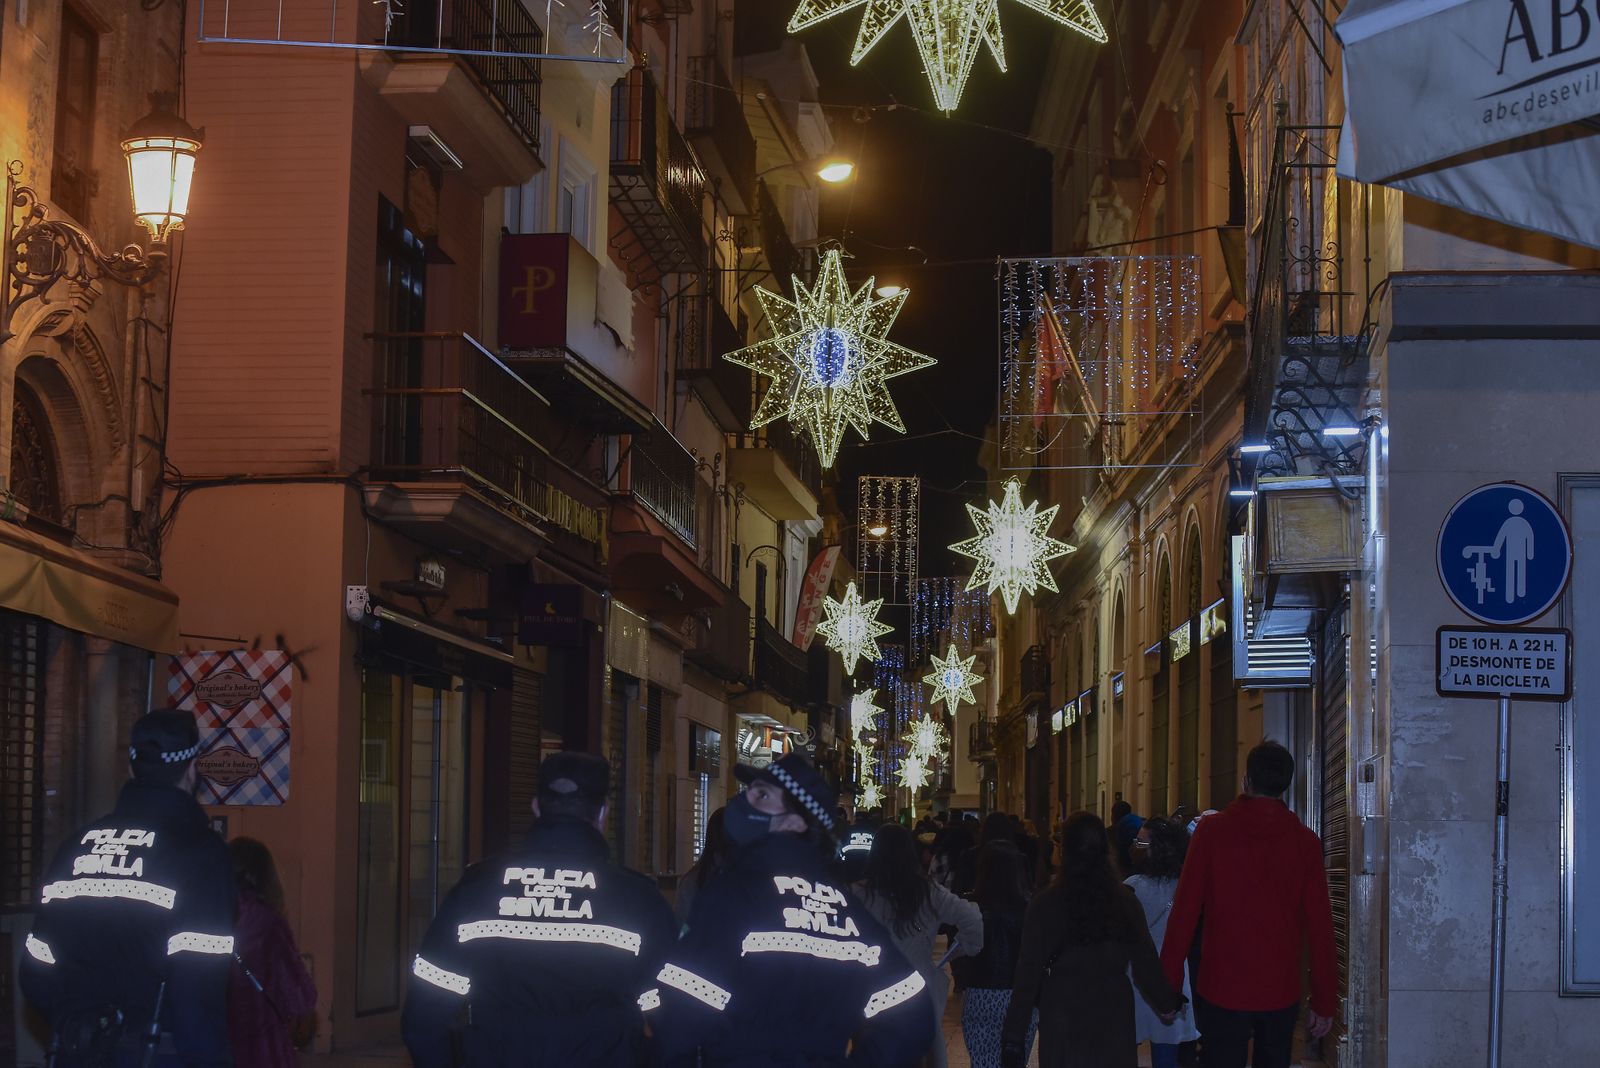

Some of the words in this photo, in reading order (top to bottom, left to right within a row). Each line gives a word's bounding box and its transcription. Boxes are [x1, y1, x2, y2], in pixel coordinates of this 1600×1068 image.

[1496, 0, 1600, 75] AB
[1449, 637, 1467, 649] DE
[1472, 638, 1487, 649] 10
[1490, 639, 1503, 650] H.
[1508, 639, 1518, 651] A
[1523, 639, 1541, 651] 22
[1544, 640, 1557, 652] H.
[1450, 655, 1532, 670] DESMONTE
[1536, 658, 1555, 670] DE
[1454, 673, 1472, 686] LA
[1476, 674, 1551, 688] BICICLETA
[197, 683, 233, 693] Original's
[235, 683, 259, 694] bakery
[232, 760, 257, 769] bakery
[504, 867, 596, 889] POLICIA
[524, 884, 572, 899] LOCAL
[499, 896, 593, 919] SEVILLA
